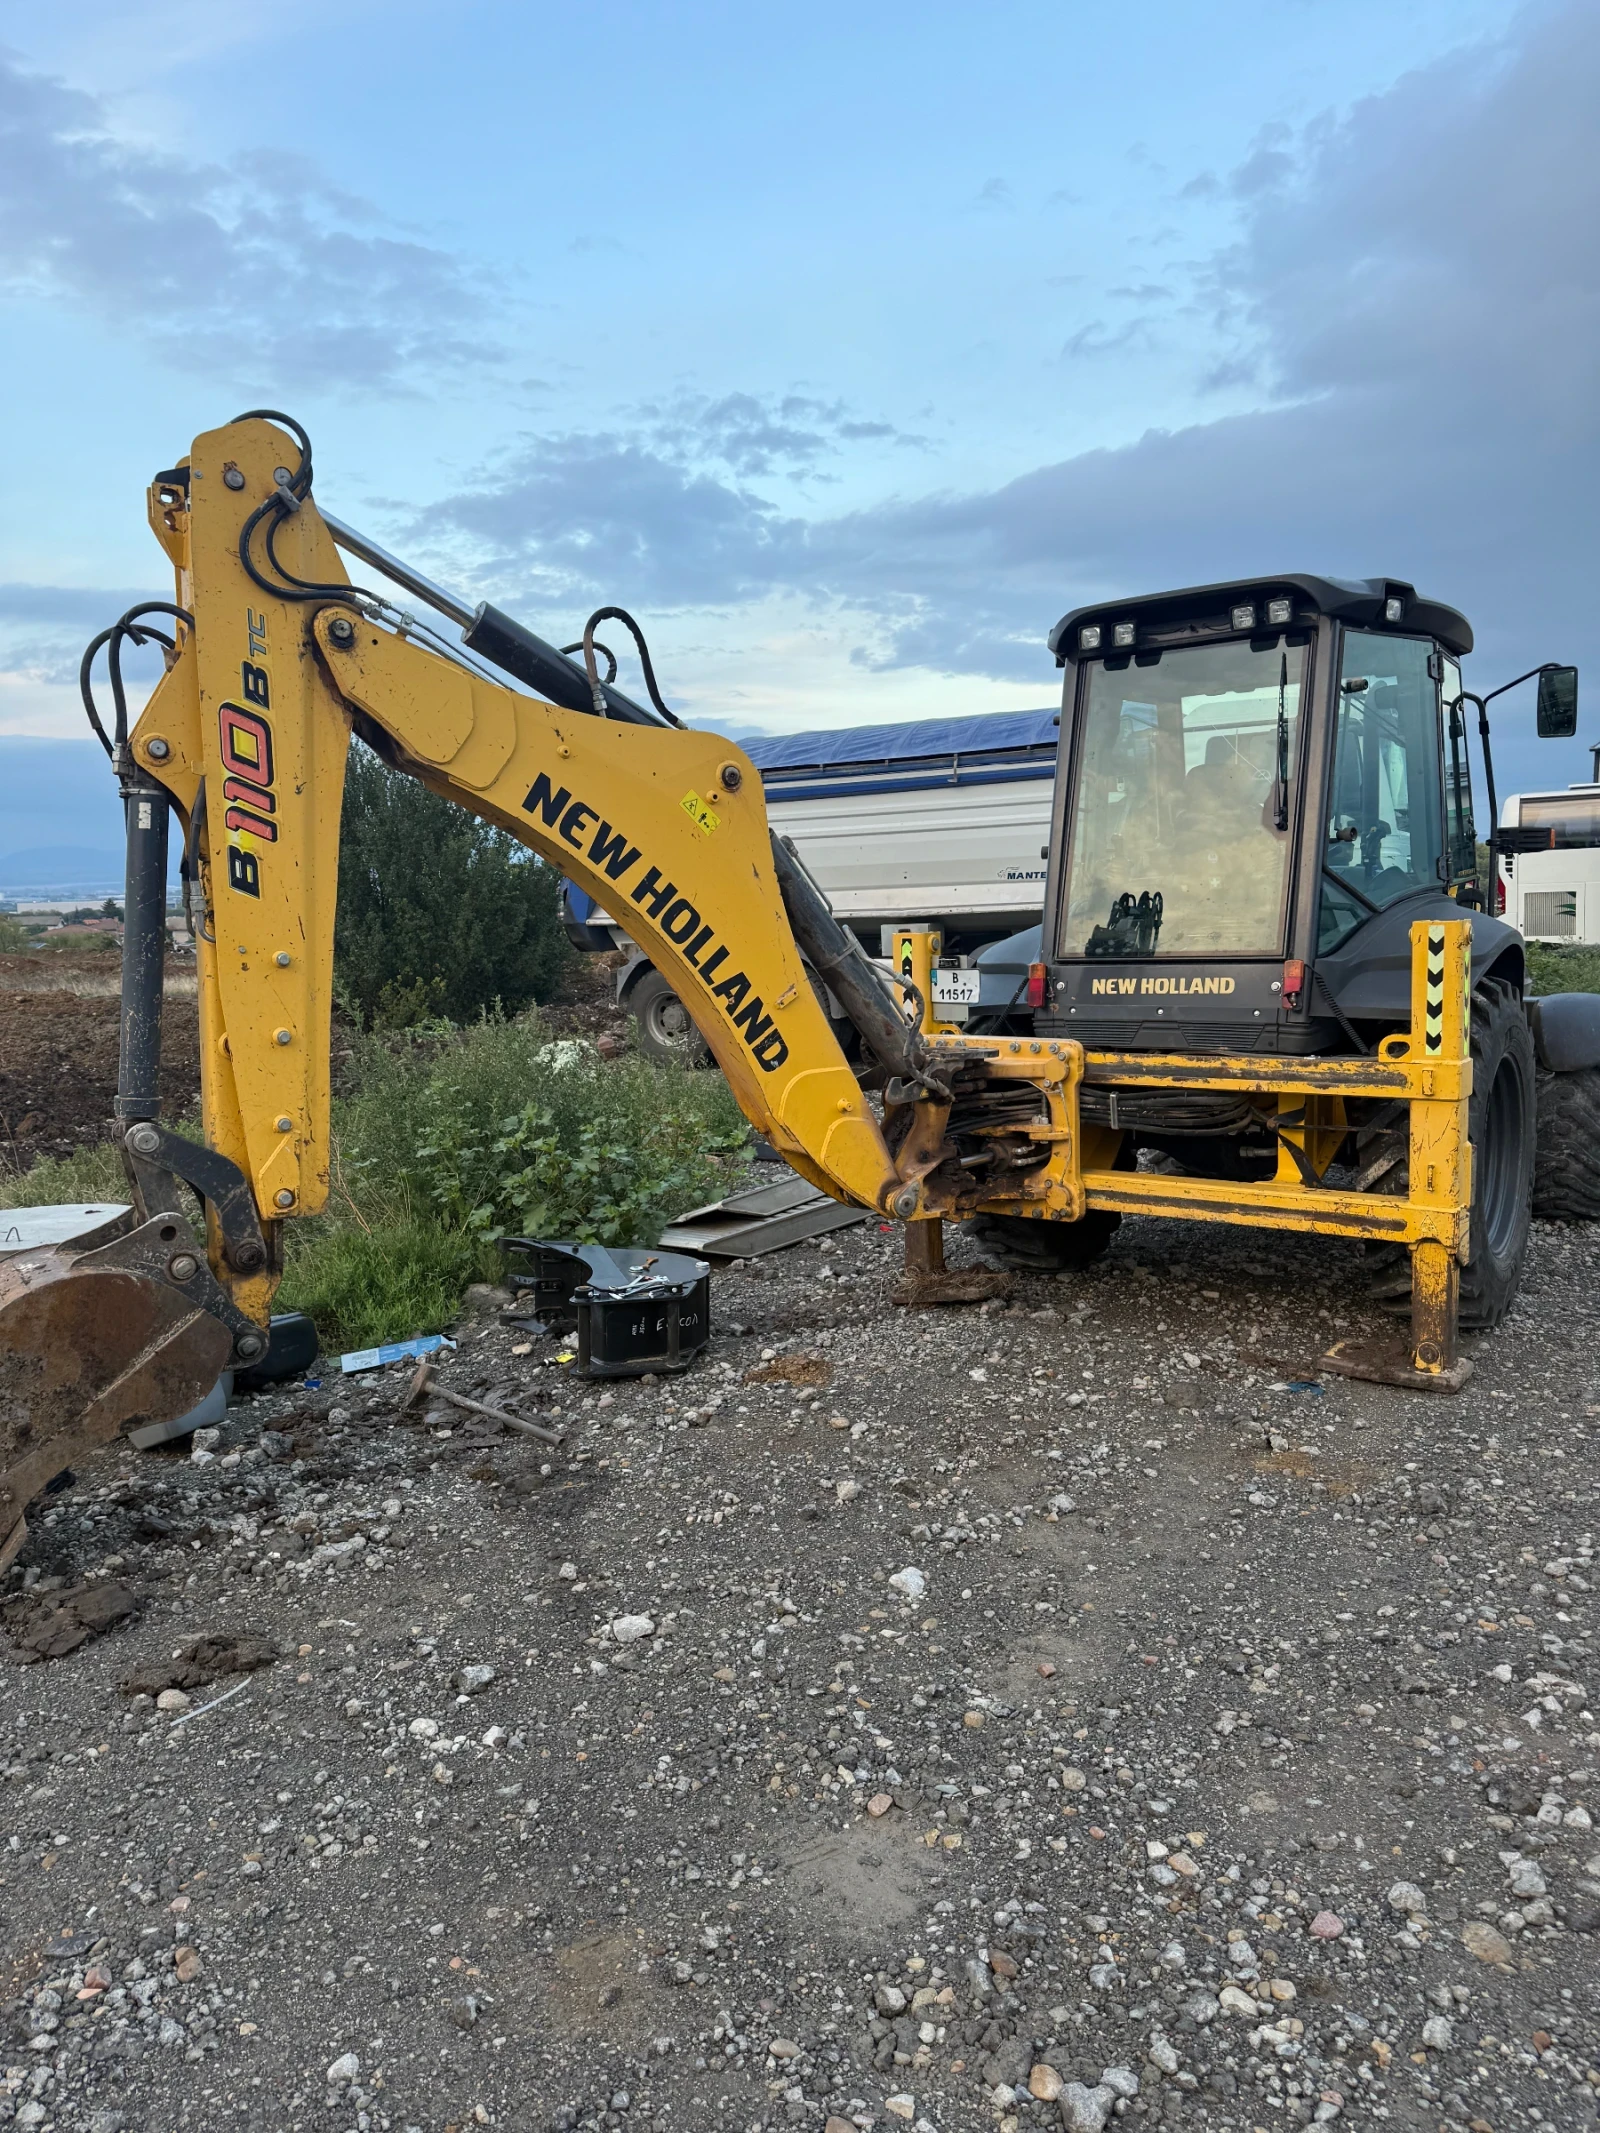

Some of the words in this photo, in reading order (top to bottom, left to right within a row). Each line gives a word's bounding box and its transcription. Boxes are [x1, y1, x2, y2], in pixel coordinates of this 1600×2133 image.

[521, 771, 643, 881] NEW
[630, 865, 789, 1073] HOLLAND
[952, 972, 959, 983] B
[1092, 978, 1137, 995] NEW
[1140, 977, 1236, 994] HOLLAND
[939, 989, 973, 1000] 11517
